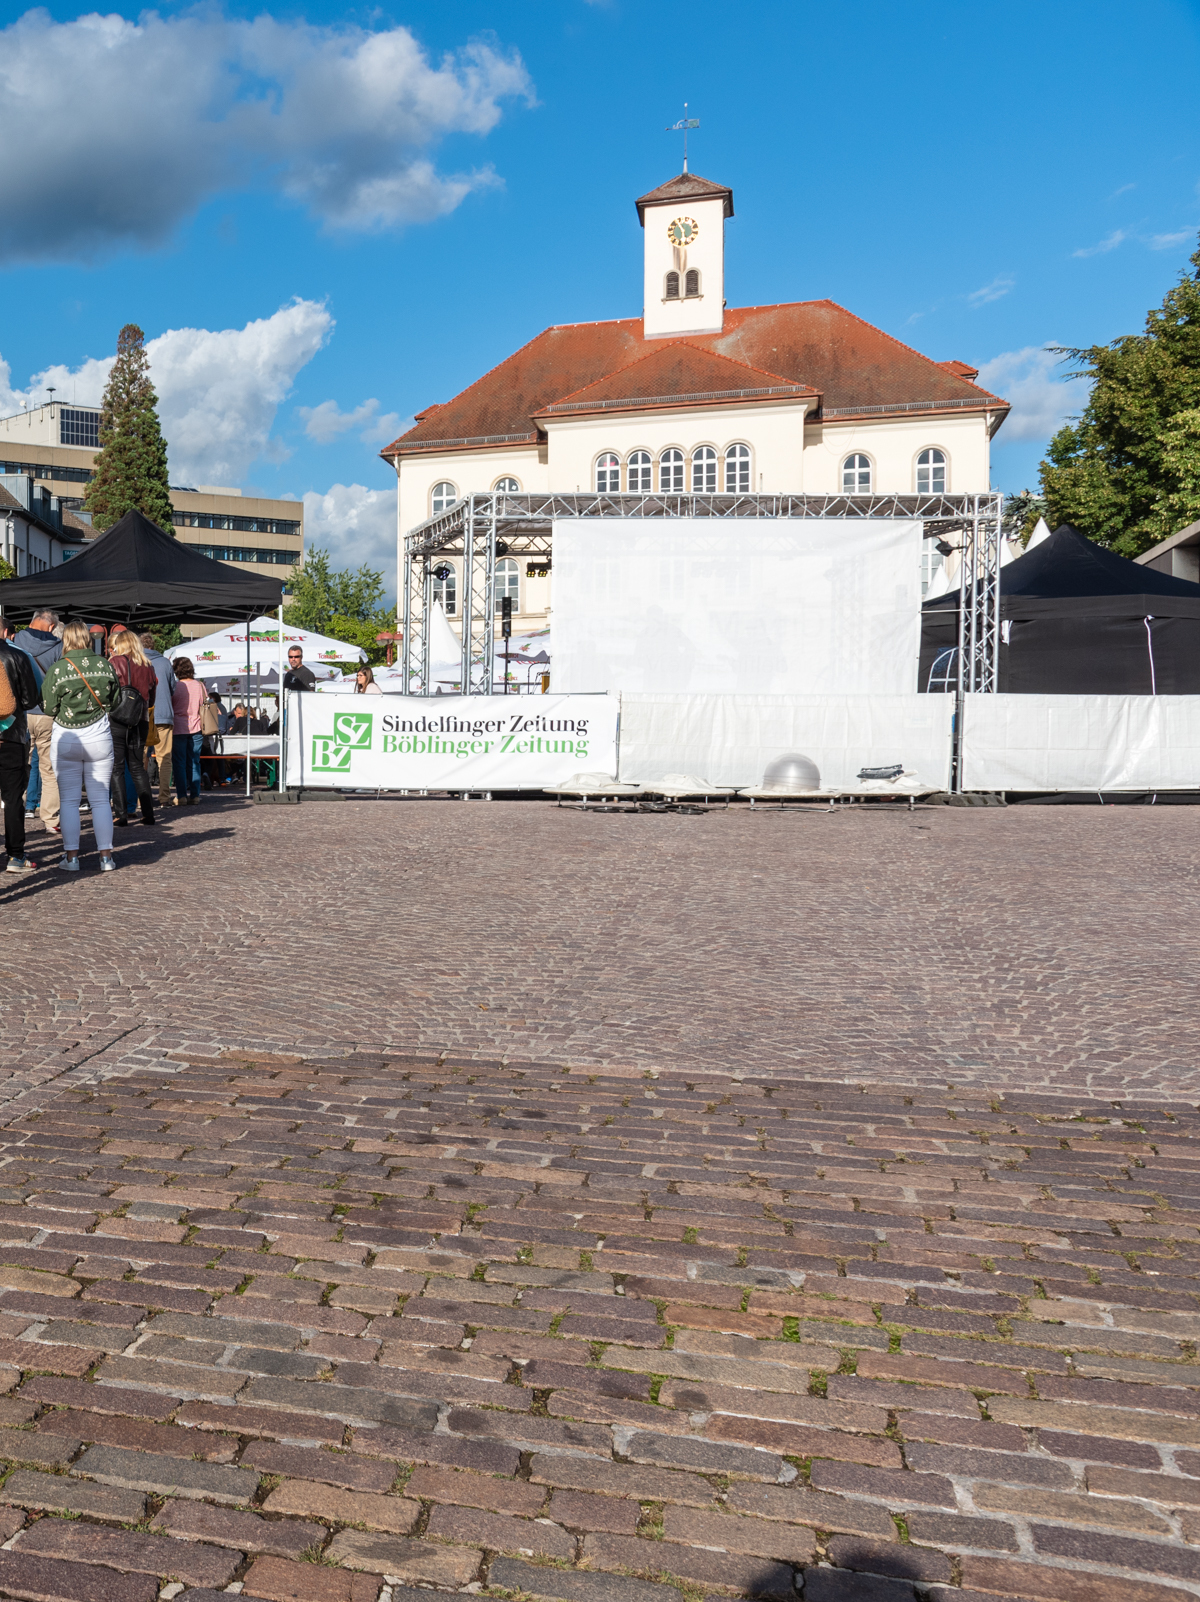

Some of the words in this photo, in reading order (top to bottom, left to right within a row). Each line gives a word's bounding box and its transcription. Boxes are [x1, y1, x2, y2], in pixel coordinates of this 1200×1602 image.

[336, 715, 370, 746] SZ
[382, 715, 505, 737] Sindelfinger
[509, 715, 589, 737] Zeitung
[312, 738, 351, 769] BZ
[381, 735, 495, 759] Böblinger
[499, 734, 590, 759] Zeitung
